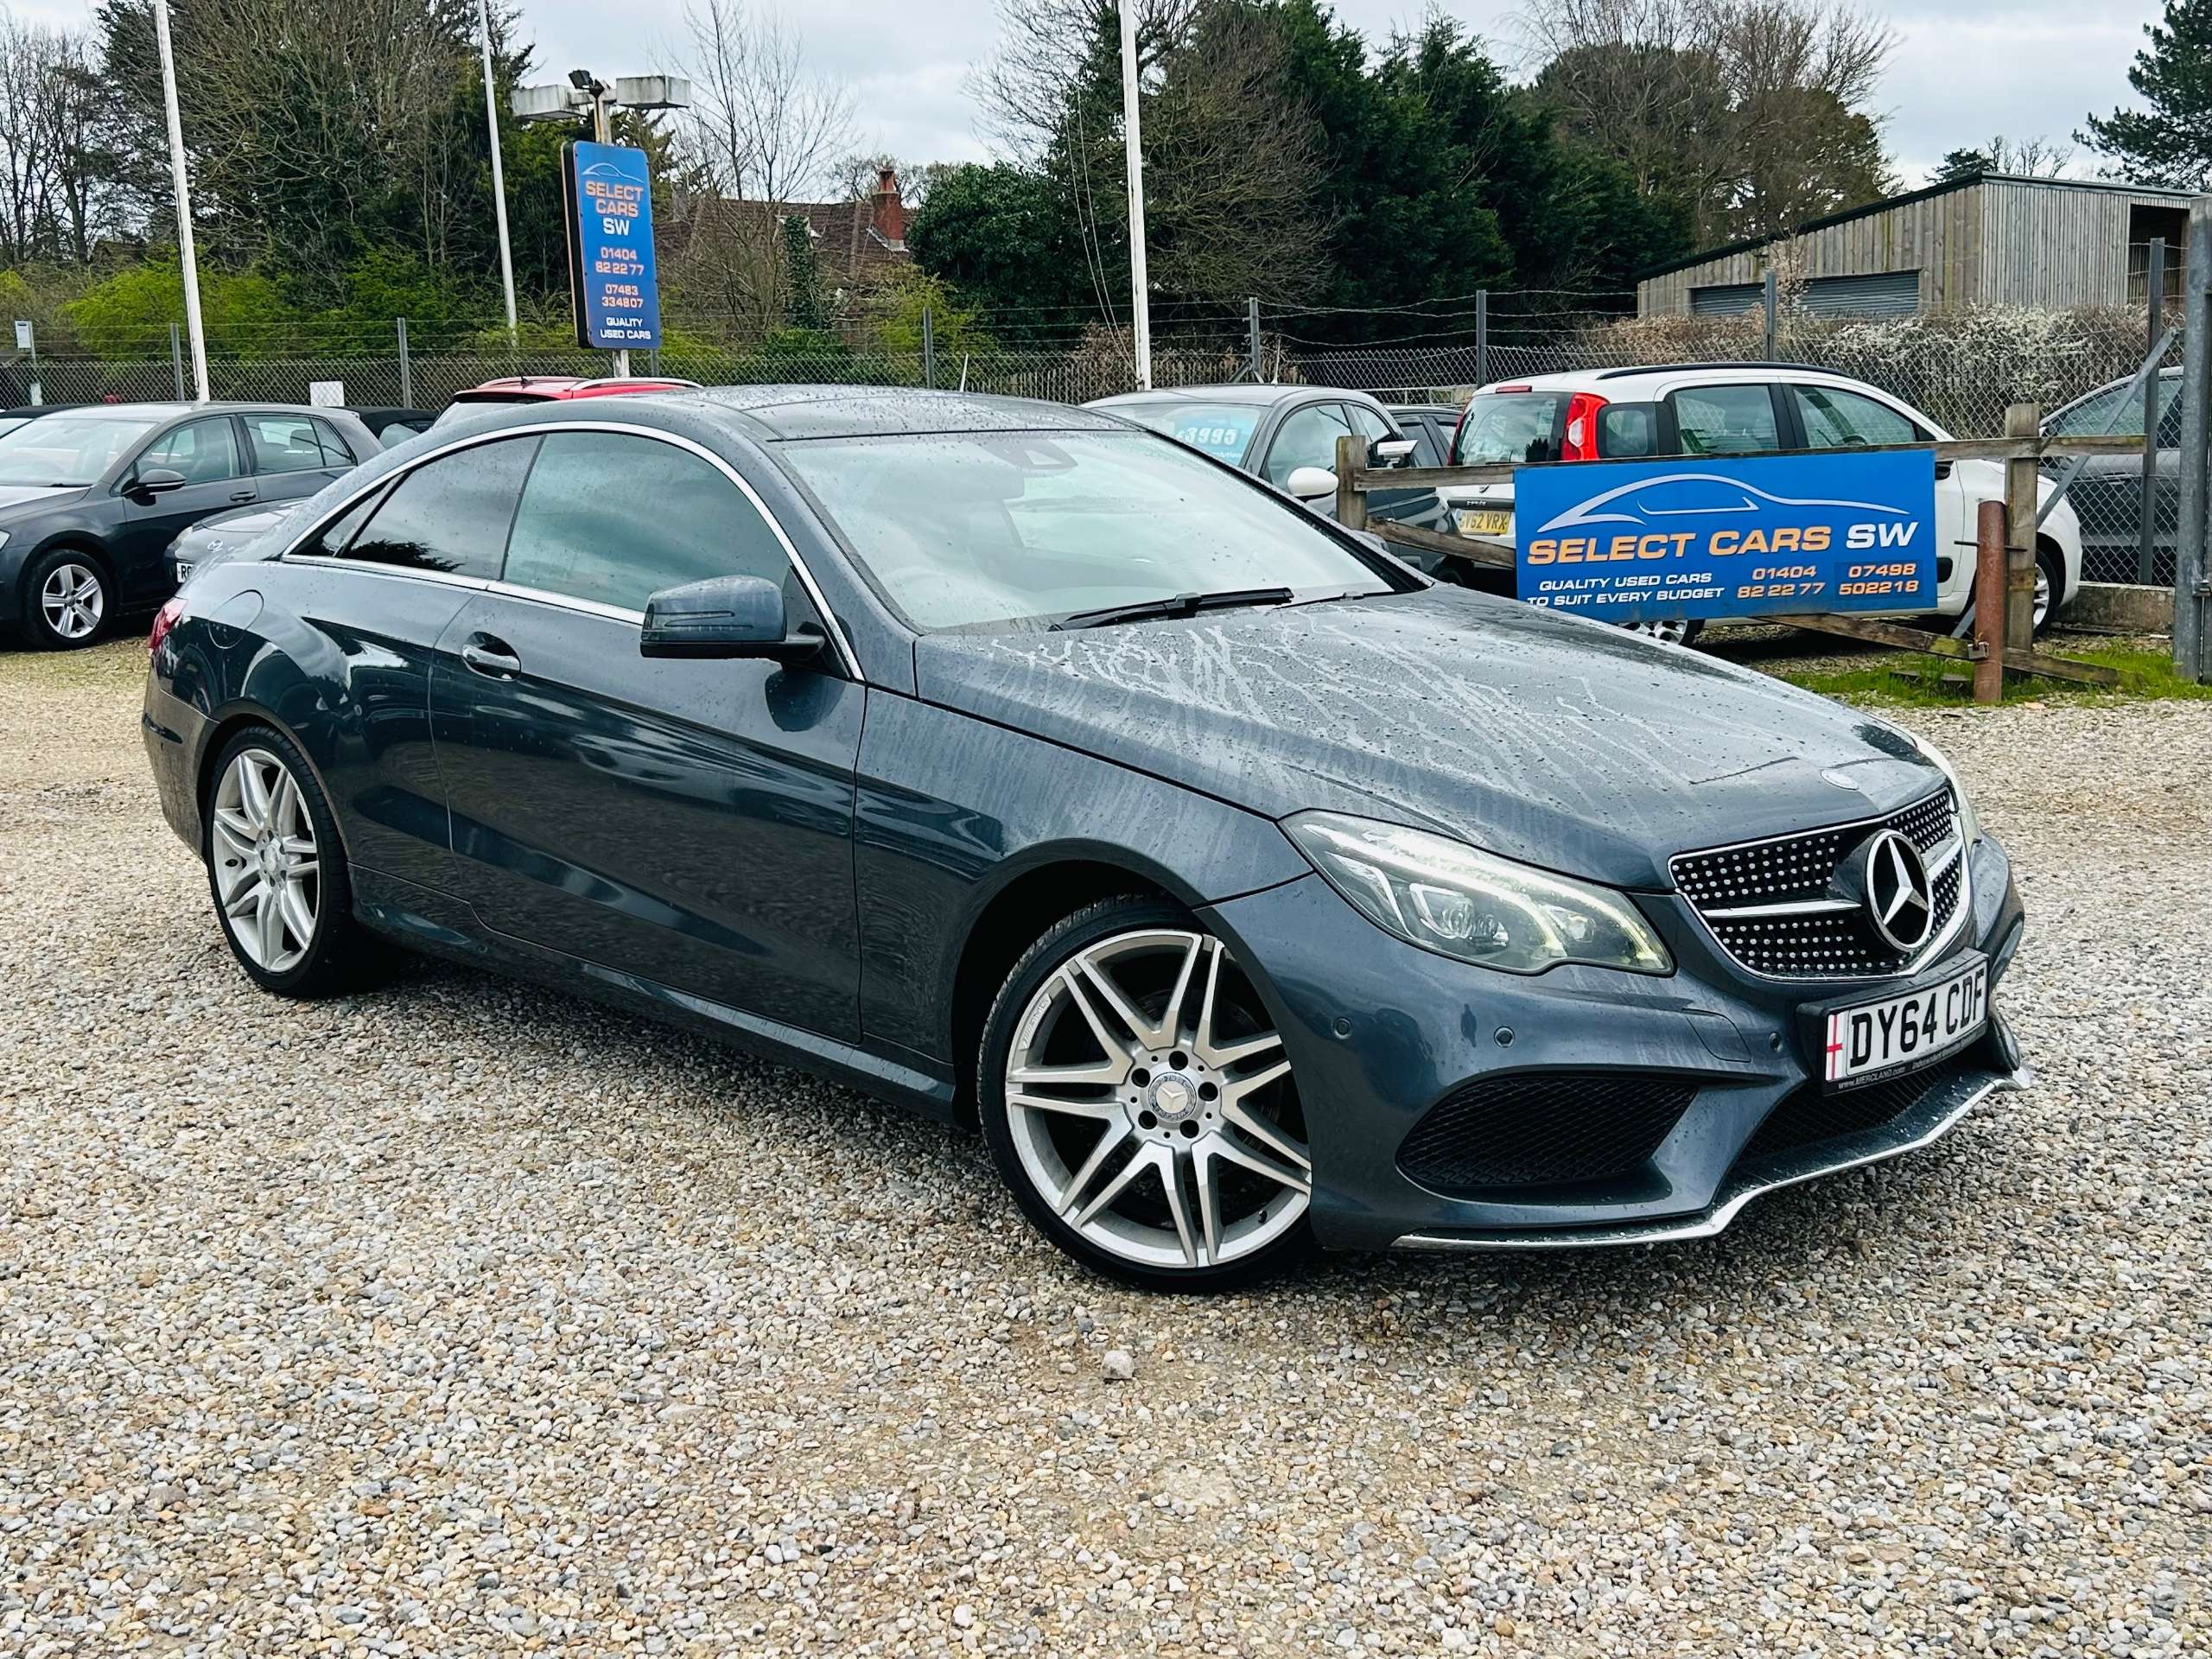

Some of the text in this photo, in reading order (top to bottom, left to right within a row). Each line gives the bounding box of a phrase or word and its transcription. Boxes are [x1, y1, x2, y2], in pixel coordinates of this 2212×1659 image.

[586, 180, 643, 201] SELECT
[596, 198, 639, 218] CARS
[603, 217, 630, 236] SW
[601, 247, 638, 260] 01404
[606, 317, 644, 327] QUALITY
[600, 329, 652, 340] USED CARS
[1486, 512, 1508, 531] VRX
[1527, 521, 1919, 565] SELECT CARS SW
[1751, 565, 1816, 581] 01404
[1847, 563, 1916, 579] 07498
[1539, 572, 1713, 591] QUALITY USED CARS
[1838, 580, 1919, 596] 502218
[1527, 587, 1725, 607] TO SUIT EVERY BUDGET
[1849, 992, 1937, 1069] DY64
[1946, 968, 1985, 1035] CDF
